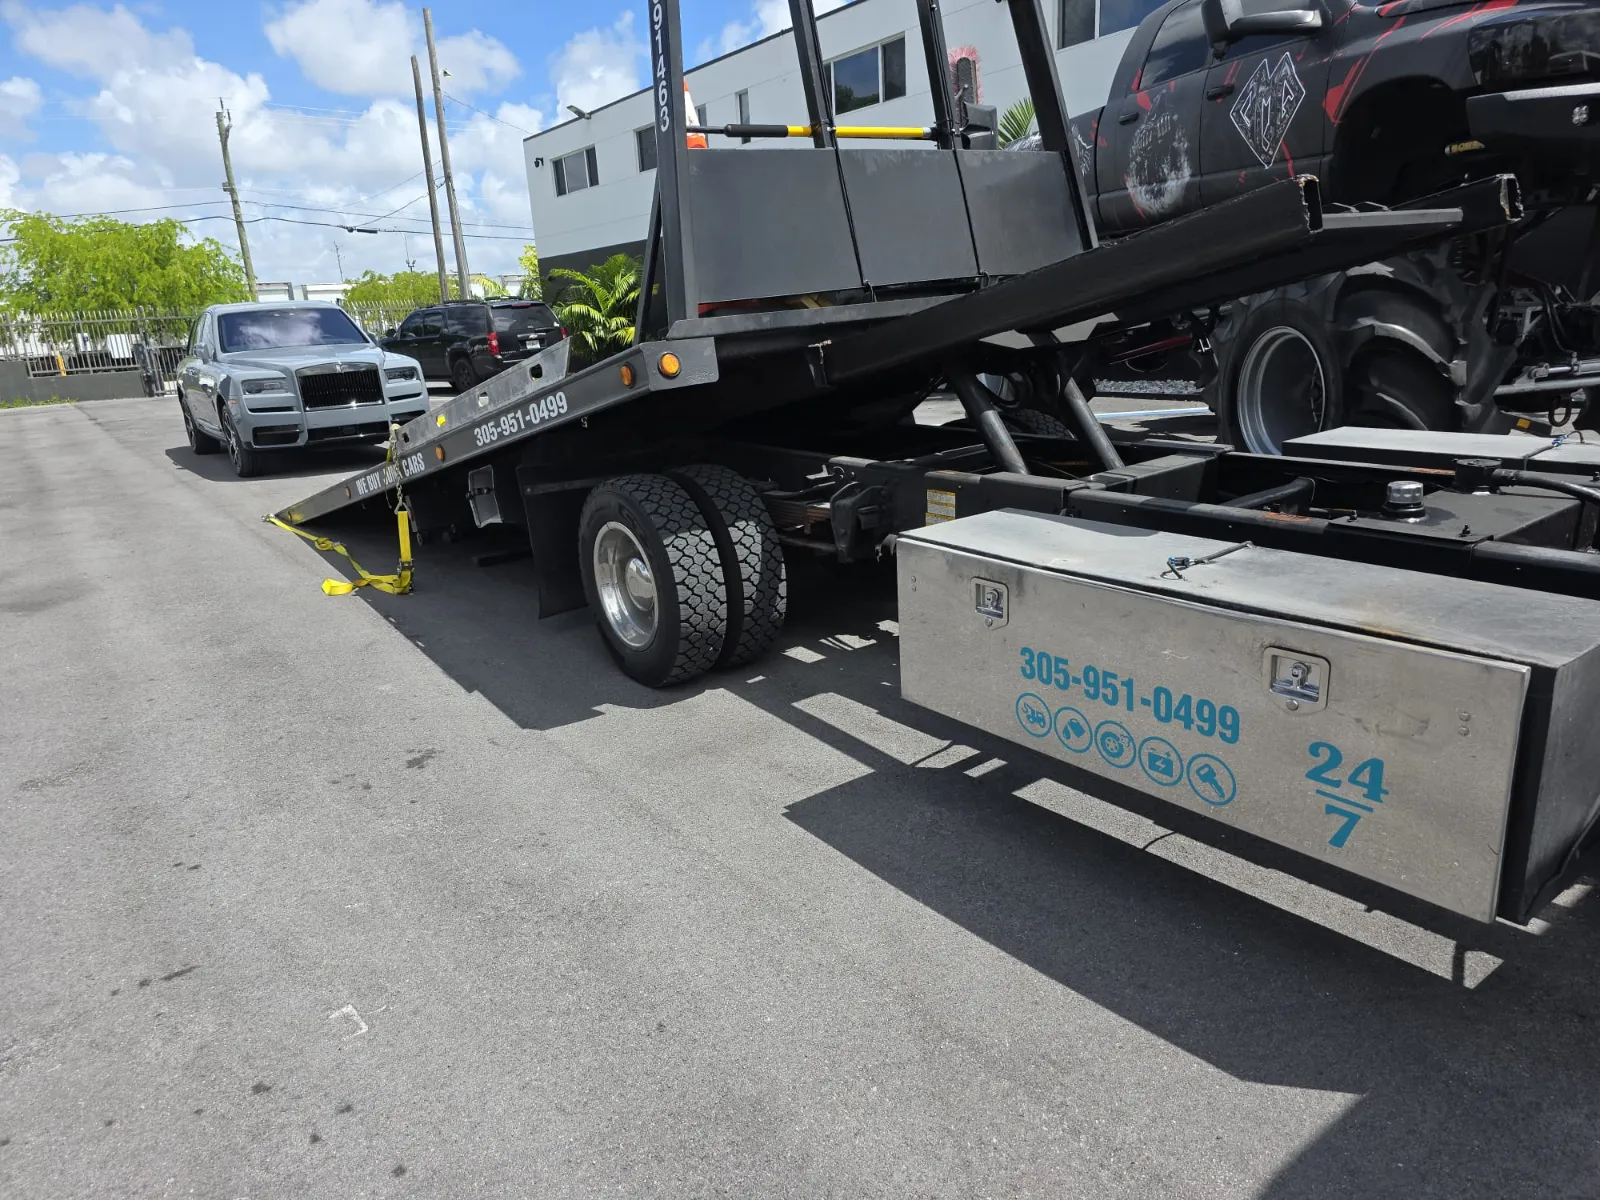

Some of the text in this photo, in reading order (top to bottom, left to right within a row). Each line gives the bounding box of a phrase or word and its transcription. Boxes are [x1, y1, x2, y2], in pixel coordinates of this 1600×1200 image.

[652, 0, 669, 132] 91463
[474, 391, 568, 447] 305-951-0499
[356, 478, 368, 495] WE
[366, 472, 381, 491] BUY
[402, 453, 425, 477] CARS
[1020, 647, 1240, 744] 305-951-0499
[1305, 741, 1389, 803] 24
[1325, 804, 1361, 848] 7
